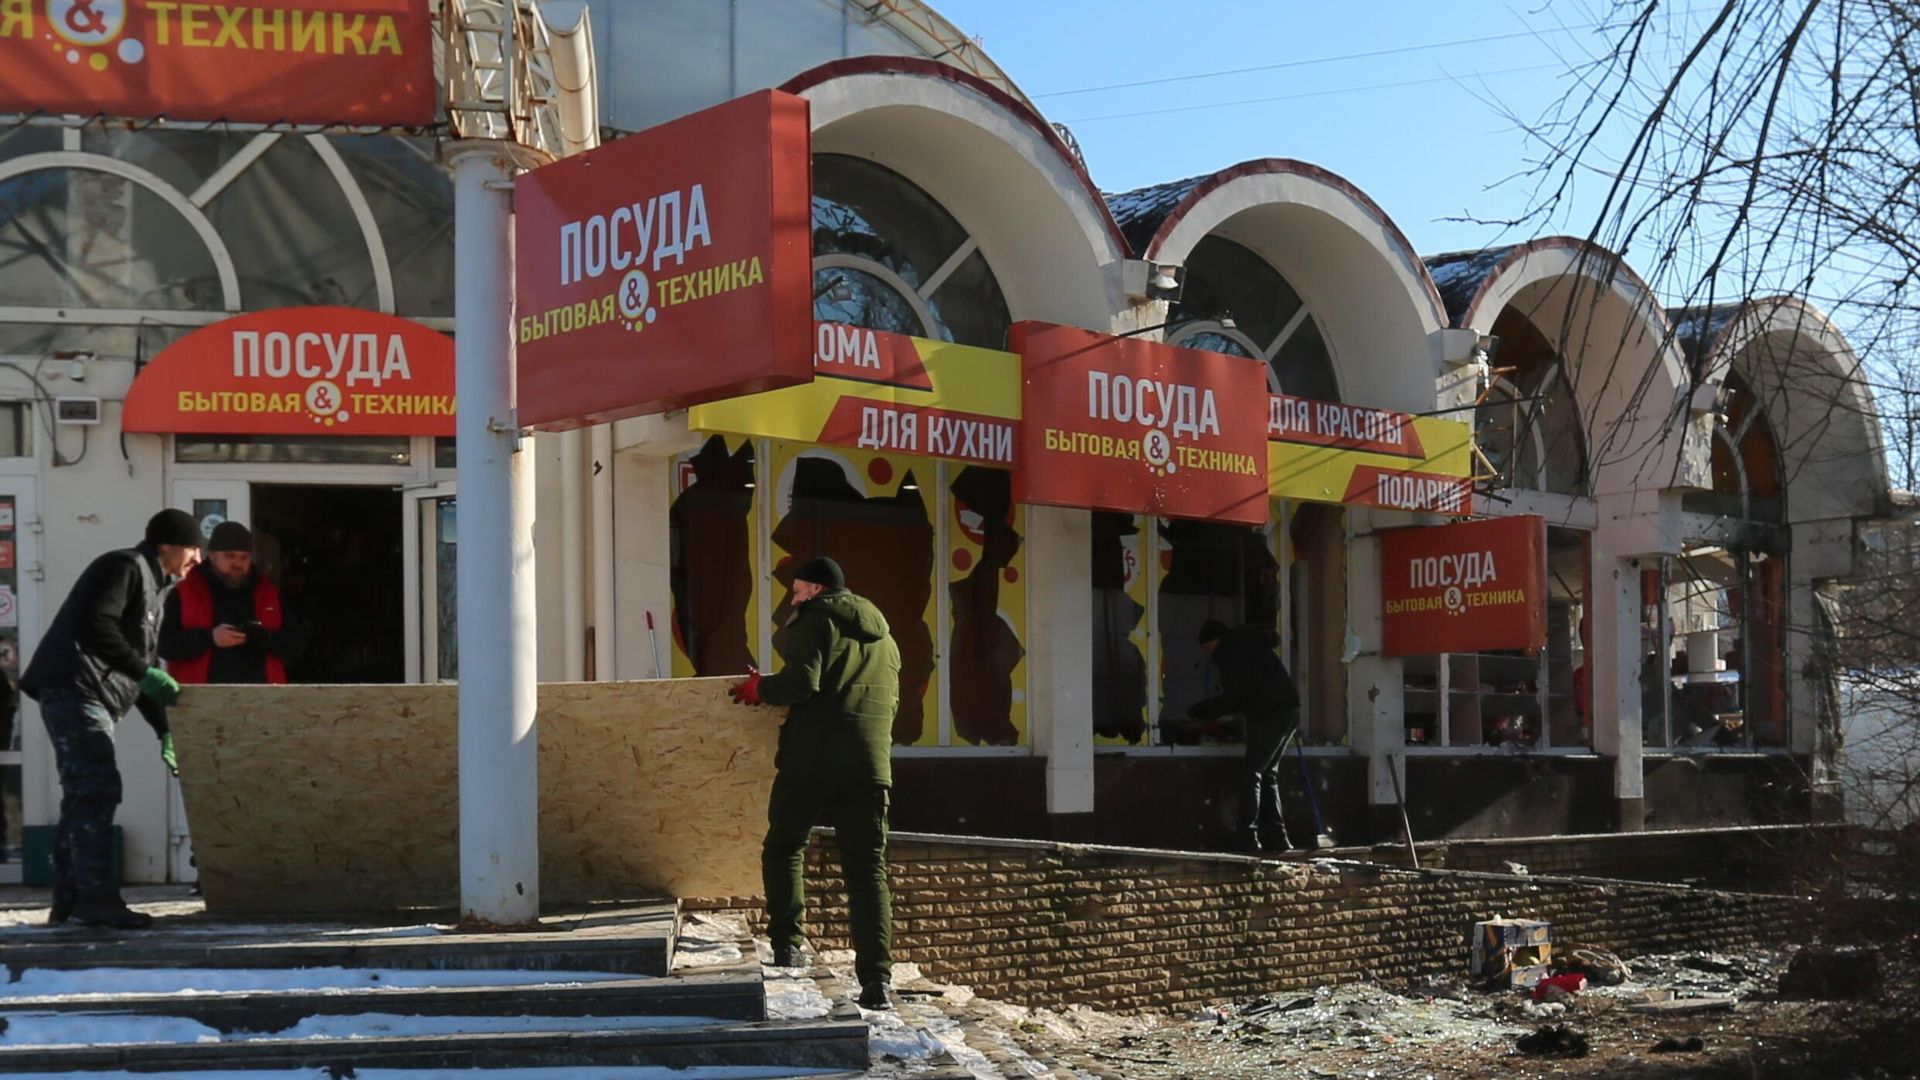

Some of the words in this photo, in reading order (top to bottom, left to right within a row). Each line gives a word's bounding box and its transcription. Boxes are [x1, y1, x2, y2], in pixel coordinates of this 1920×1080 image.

[145, 1, 403, 56] ТЕХНИКА
[559, 183, 712, 285] ПОСУДА
[520, 294, 615, 344] БЫТОВАЯ
[656, 256, 764, 308] ТЕХНИКА
[232, 330, 411, 387] ПОСУДА
[814, 323, 881, 370] ОМА
[178, 391, 301, 413] БЫТОВАЯ
[1088, 370, 1220, 440] ПОСУДА
[1267, 396, 1310, 435] ДЛЯ
[1316, 402, 1403, 446] КРАСОТЫ
[857, 407, 917, 451] ДЛЯ
[927, 415, 1013, 463] КУХНИ
[1045, 428, 1140, 460] БЫТОВАЯ
[1176, 445, 1257, 476] ТЕХНИКА
[1410, 551, 1497, 589] ПОСУДА
[1386, 595, 1443, 614] БЫТОВАЯ
[1466, 589, 1526, 608] ТЕХНИКА
